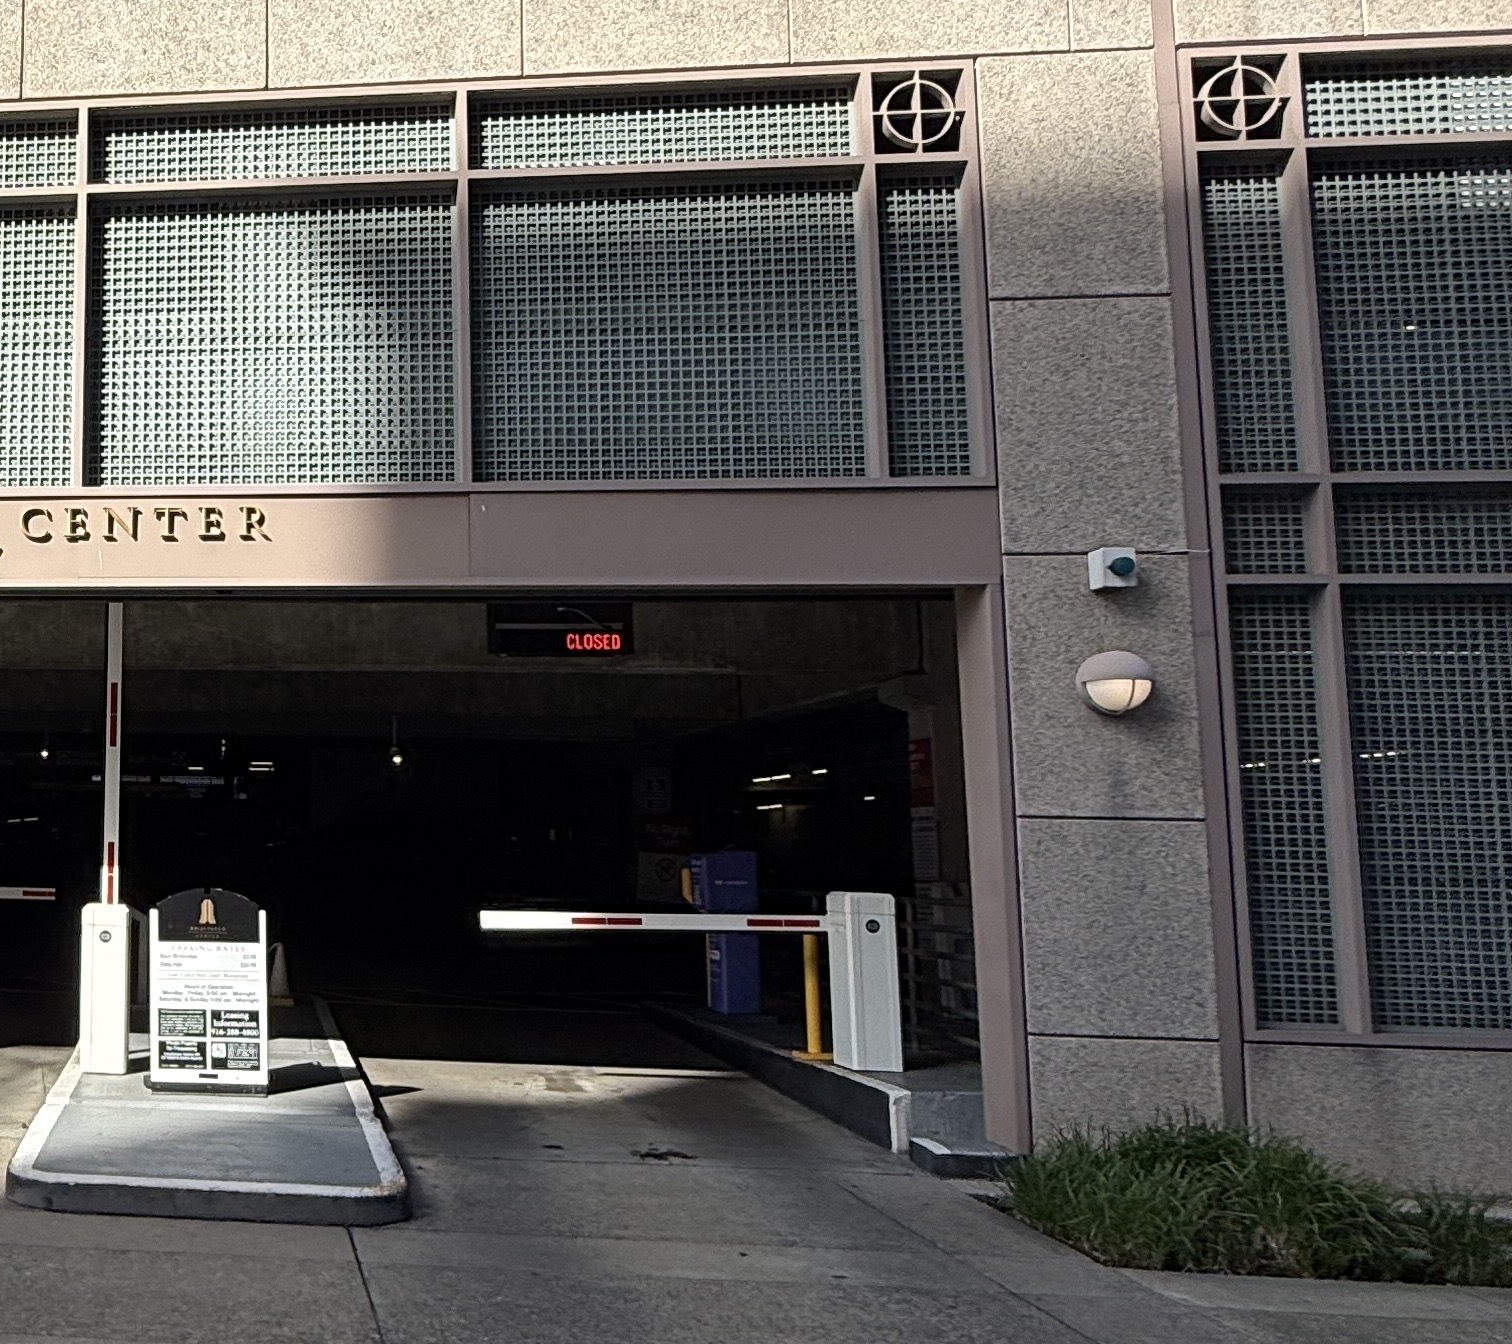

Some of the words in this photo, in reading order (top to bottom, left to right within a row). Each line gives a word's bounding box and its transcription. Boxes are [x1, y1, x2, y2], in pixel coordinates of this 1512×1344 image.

[21, 506, 273, 543] CENTER
[567, 633, 621, 650] CLOSED
[220, 1010, 249, 1022] Leasing
[213, 1019, 258, 1028] Information
